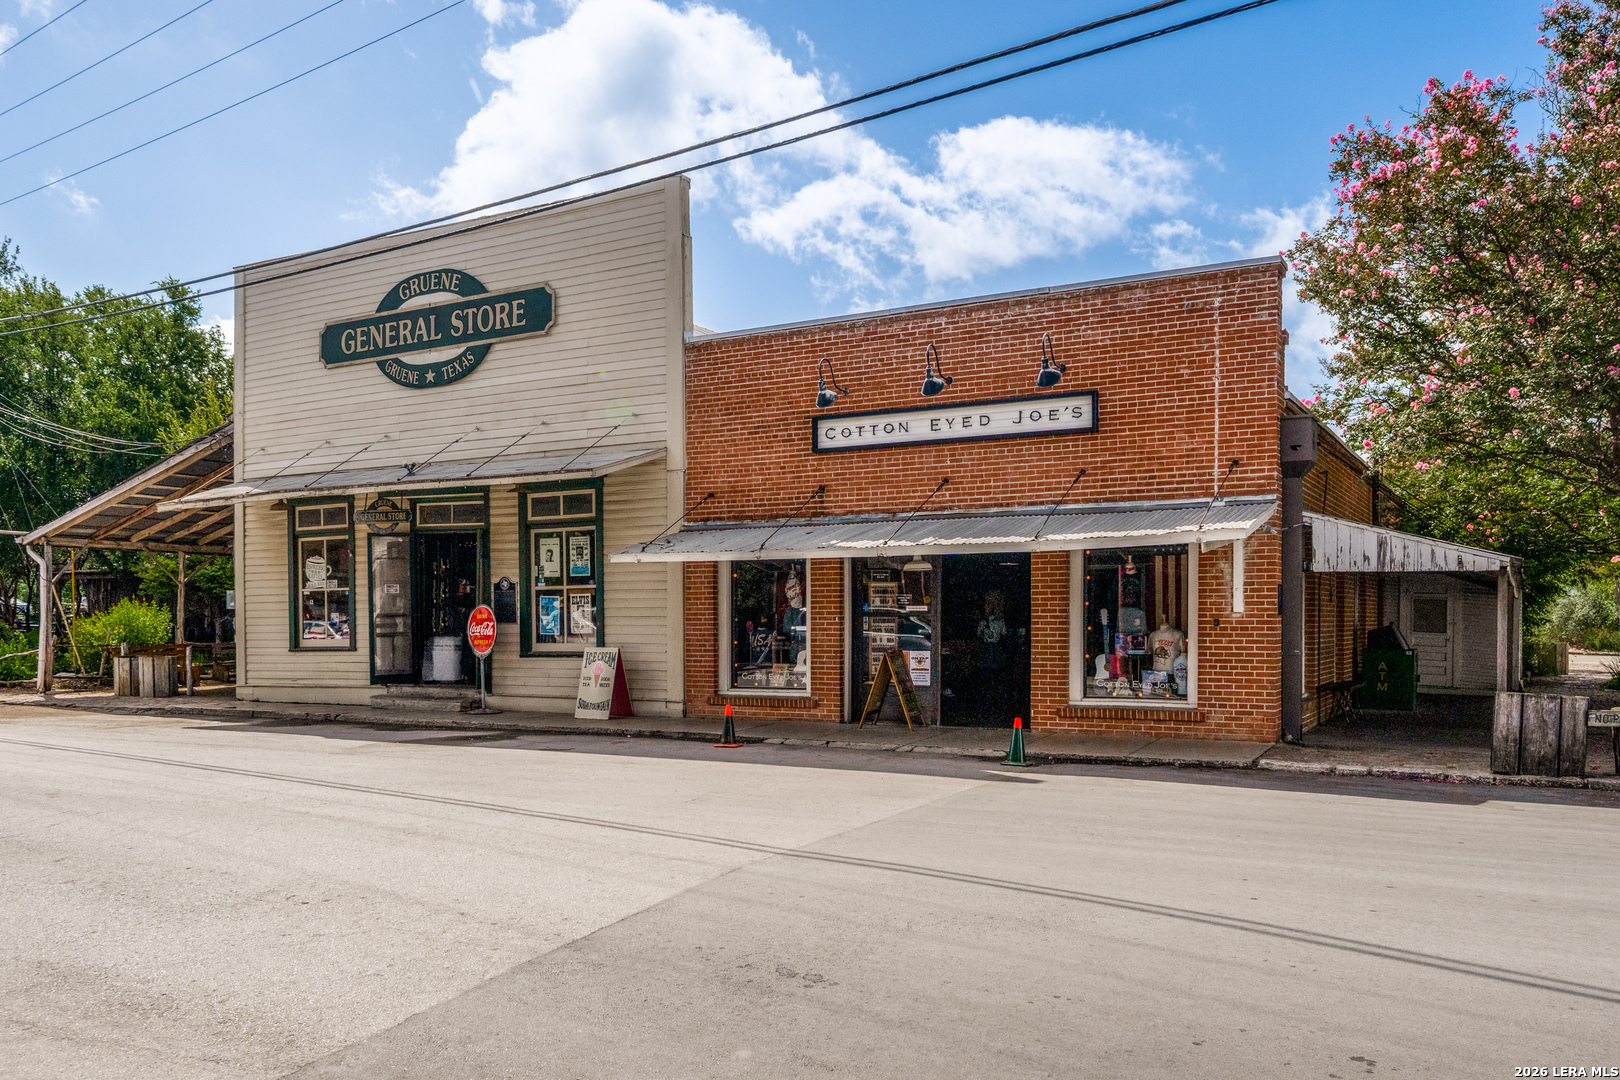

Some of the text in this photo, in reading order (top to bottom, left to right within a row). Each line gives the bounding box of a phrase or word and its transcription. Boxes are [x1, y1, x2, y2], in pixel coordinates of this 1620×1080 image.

[399, 272, 462, 300] GRUENE
[340, 299, 526, 355] GENERAL STORE
[385, 350, 475, 385] GRUENE TEXAS
[825, 406, 1084, 440] COTTON EYED JOE'S
[360, 511, 407, 521] GENERAL STORE
[571, 595, 590, 605] ELVIS
[584, 651, 617, 670] ICE CREAM
[1096, 679, 1130, 688] COTTON
[1132, 680, 1152, 688] EYED
[1377, 661, 1388, 692] ATM
[1594, 714, 1609, 724] NO
